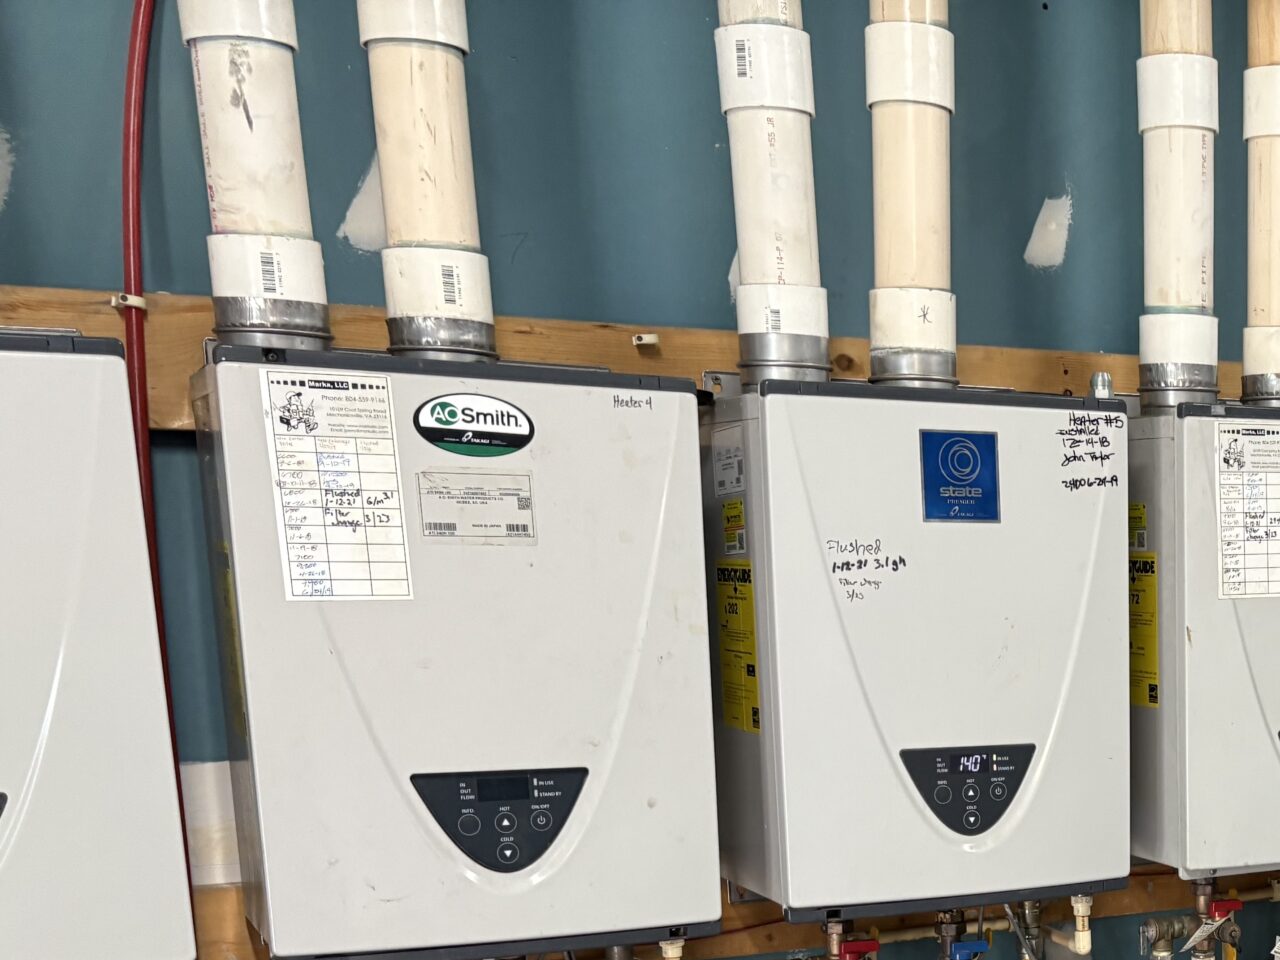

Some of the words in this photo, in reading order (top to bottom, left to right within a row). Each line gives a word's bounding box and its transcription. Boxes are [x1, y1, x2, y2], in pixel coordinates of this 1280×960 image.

[613, 394, 643, 409] Heater
[645, 396, 653, 410] 4
[324, 489, 361, 498] Flushed
[940, 485, 983, 497] state
[827, 539, 882, 556] Flushed
